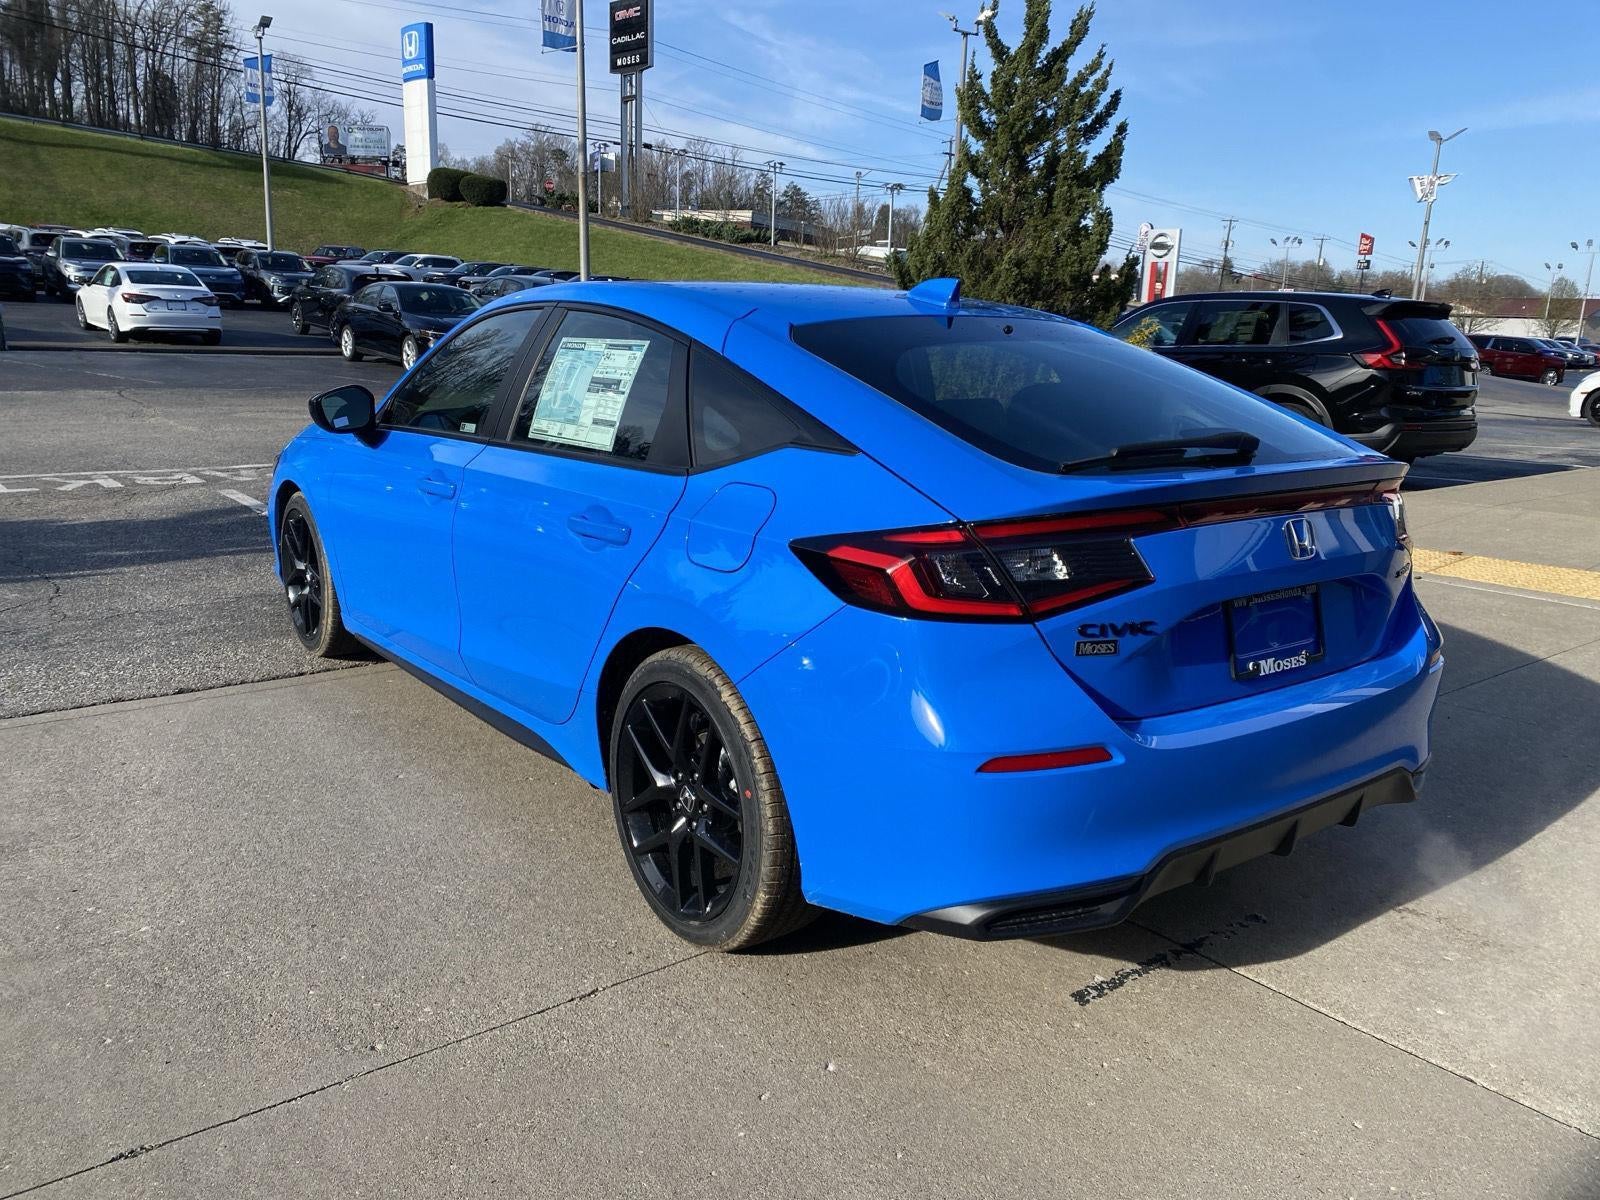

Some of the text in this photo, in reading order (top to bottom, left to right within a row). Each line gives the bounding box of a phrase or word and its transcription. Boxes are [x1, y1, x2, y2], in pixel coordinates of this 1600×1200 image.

[544, 14, 576, 28] HONDA
[614, 6, 641, 22] GMC
[611, 31, 645, 45] CADILLAC
[616, 54, 640, 67] MOSES
[402, 63, 425, 74] HONDA
[566, 341, 585, 349] HONDA
[1077, 621, 1160, 638] CIVIC
